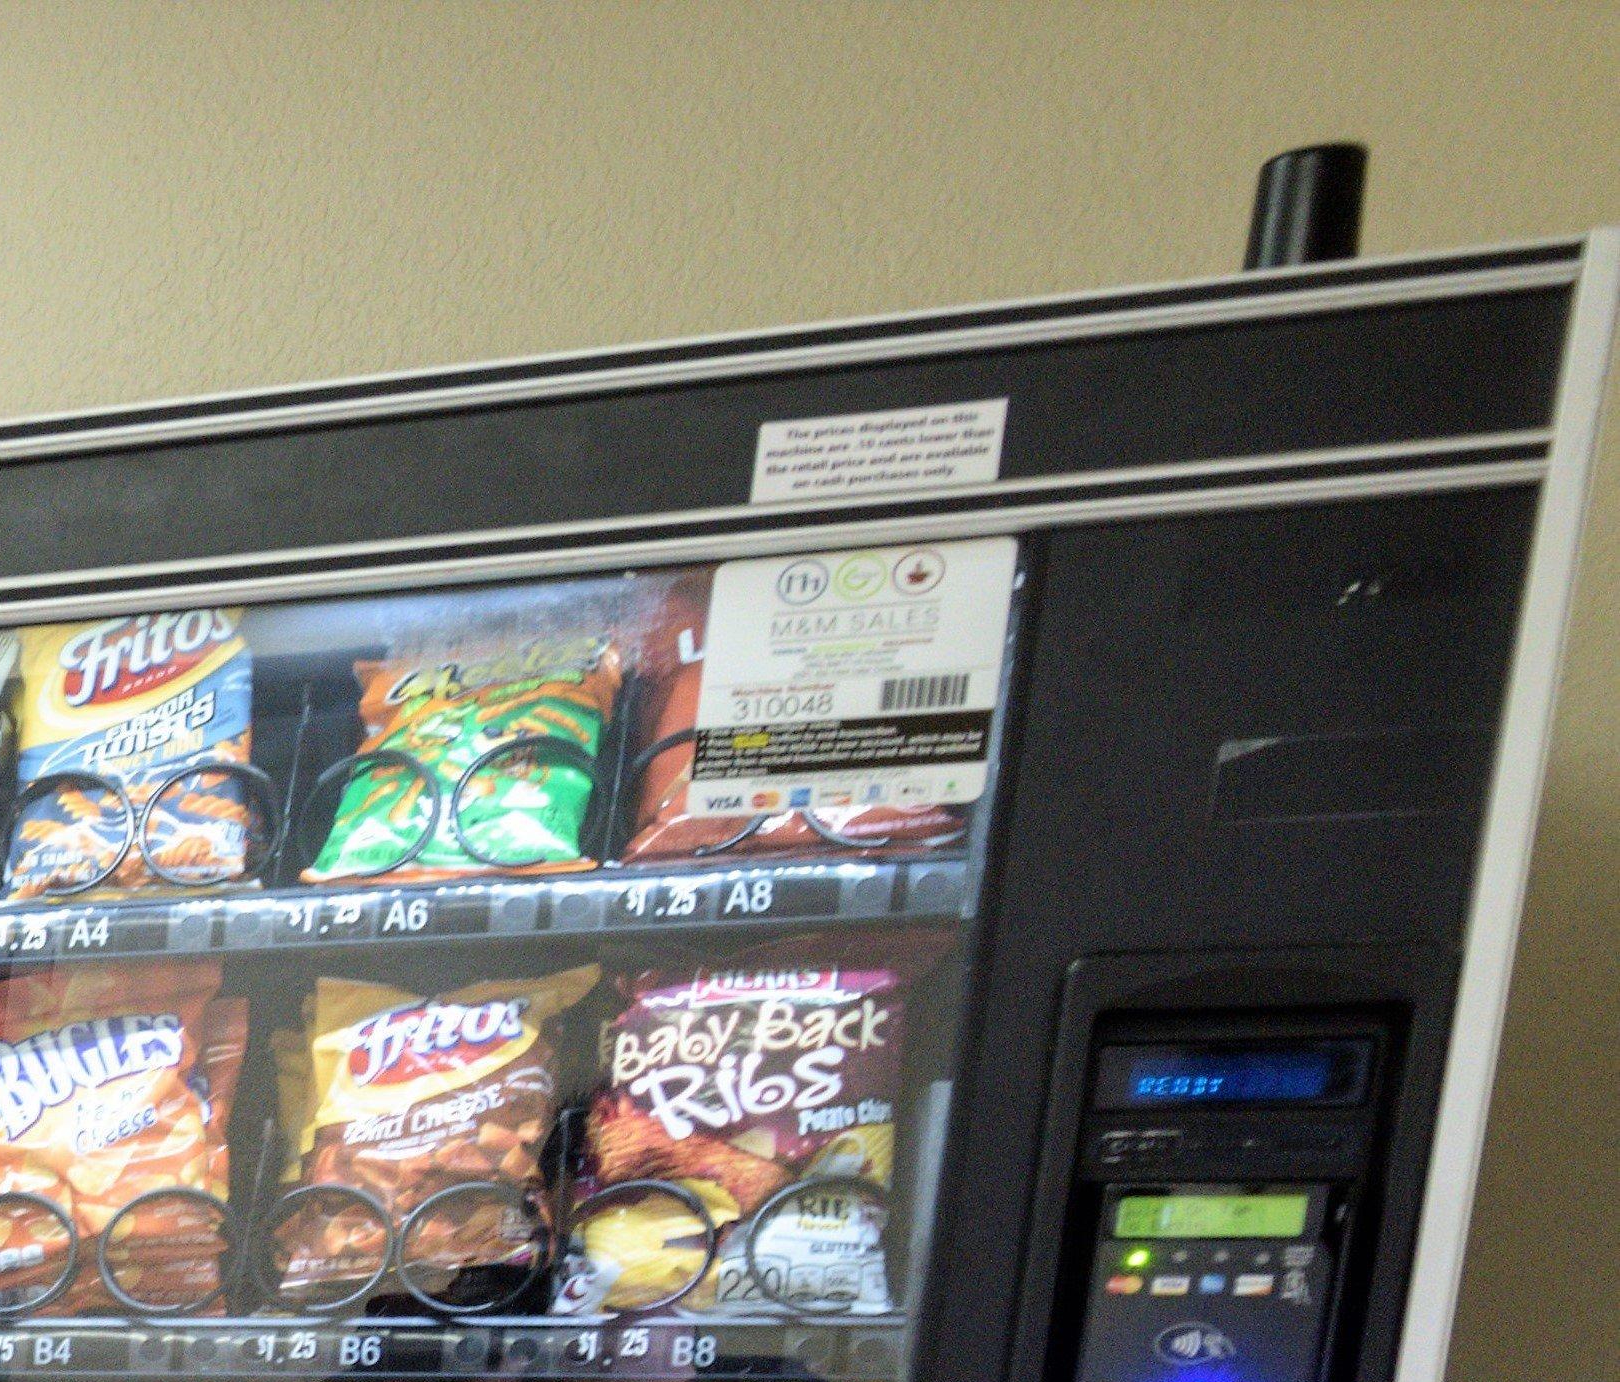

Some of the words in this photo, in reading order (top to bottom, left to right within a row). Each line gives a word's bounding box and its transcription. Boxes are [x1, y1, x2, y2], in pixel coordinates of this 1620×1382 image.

[769, 614, 838, 637] M&M
[849, 605, 942, 629] SALES
[104, 687, 197, 740] FLAVOR
[732, 691, 834, 722] 310048
[707, 795, 744, 811] VISA
[725, 880, 773, 914] A8
[382, 898, 429, 932] A6
[69, 918, 110, 947] A4
[611, 1009, 740, 1087] Baby
[753, 1000, 889, 1052] Back
[629, 1046, 846, 1141] Ribs
[798, 1105, 858, 1136] Potato
[719, 1265, 782, 1303] 220
[32, 1335, 74, 1364] B4
[338, 1336, 382, 1366] B6
[670, 1334, 718, 1367] B8
